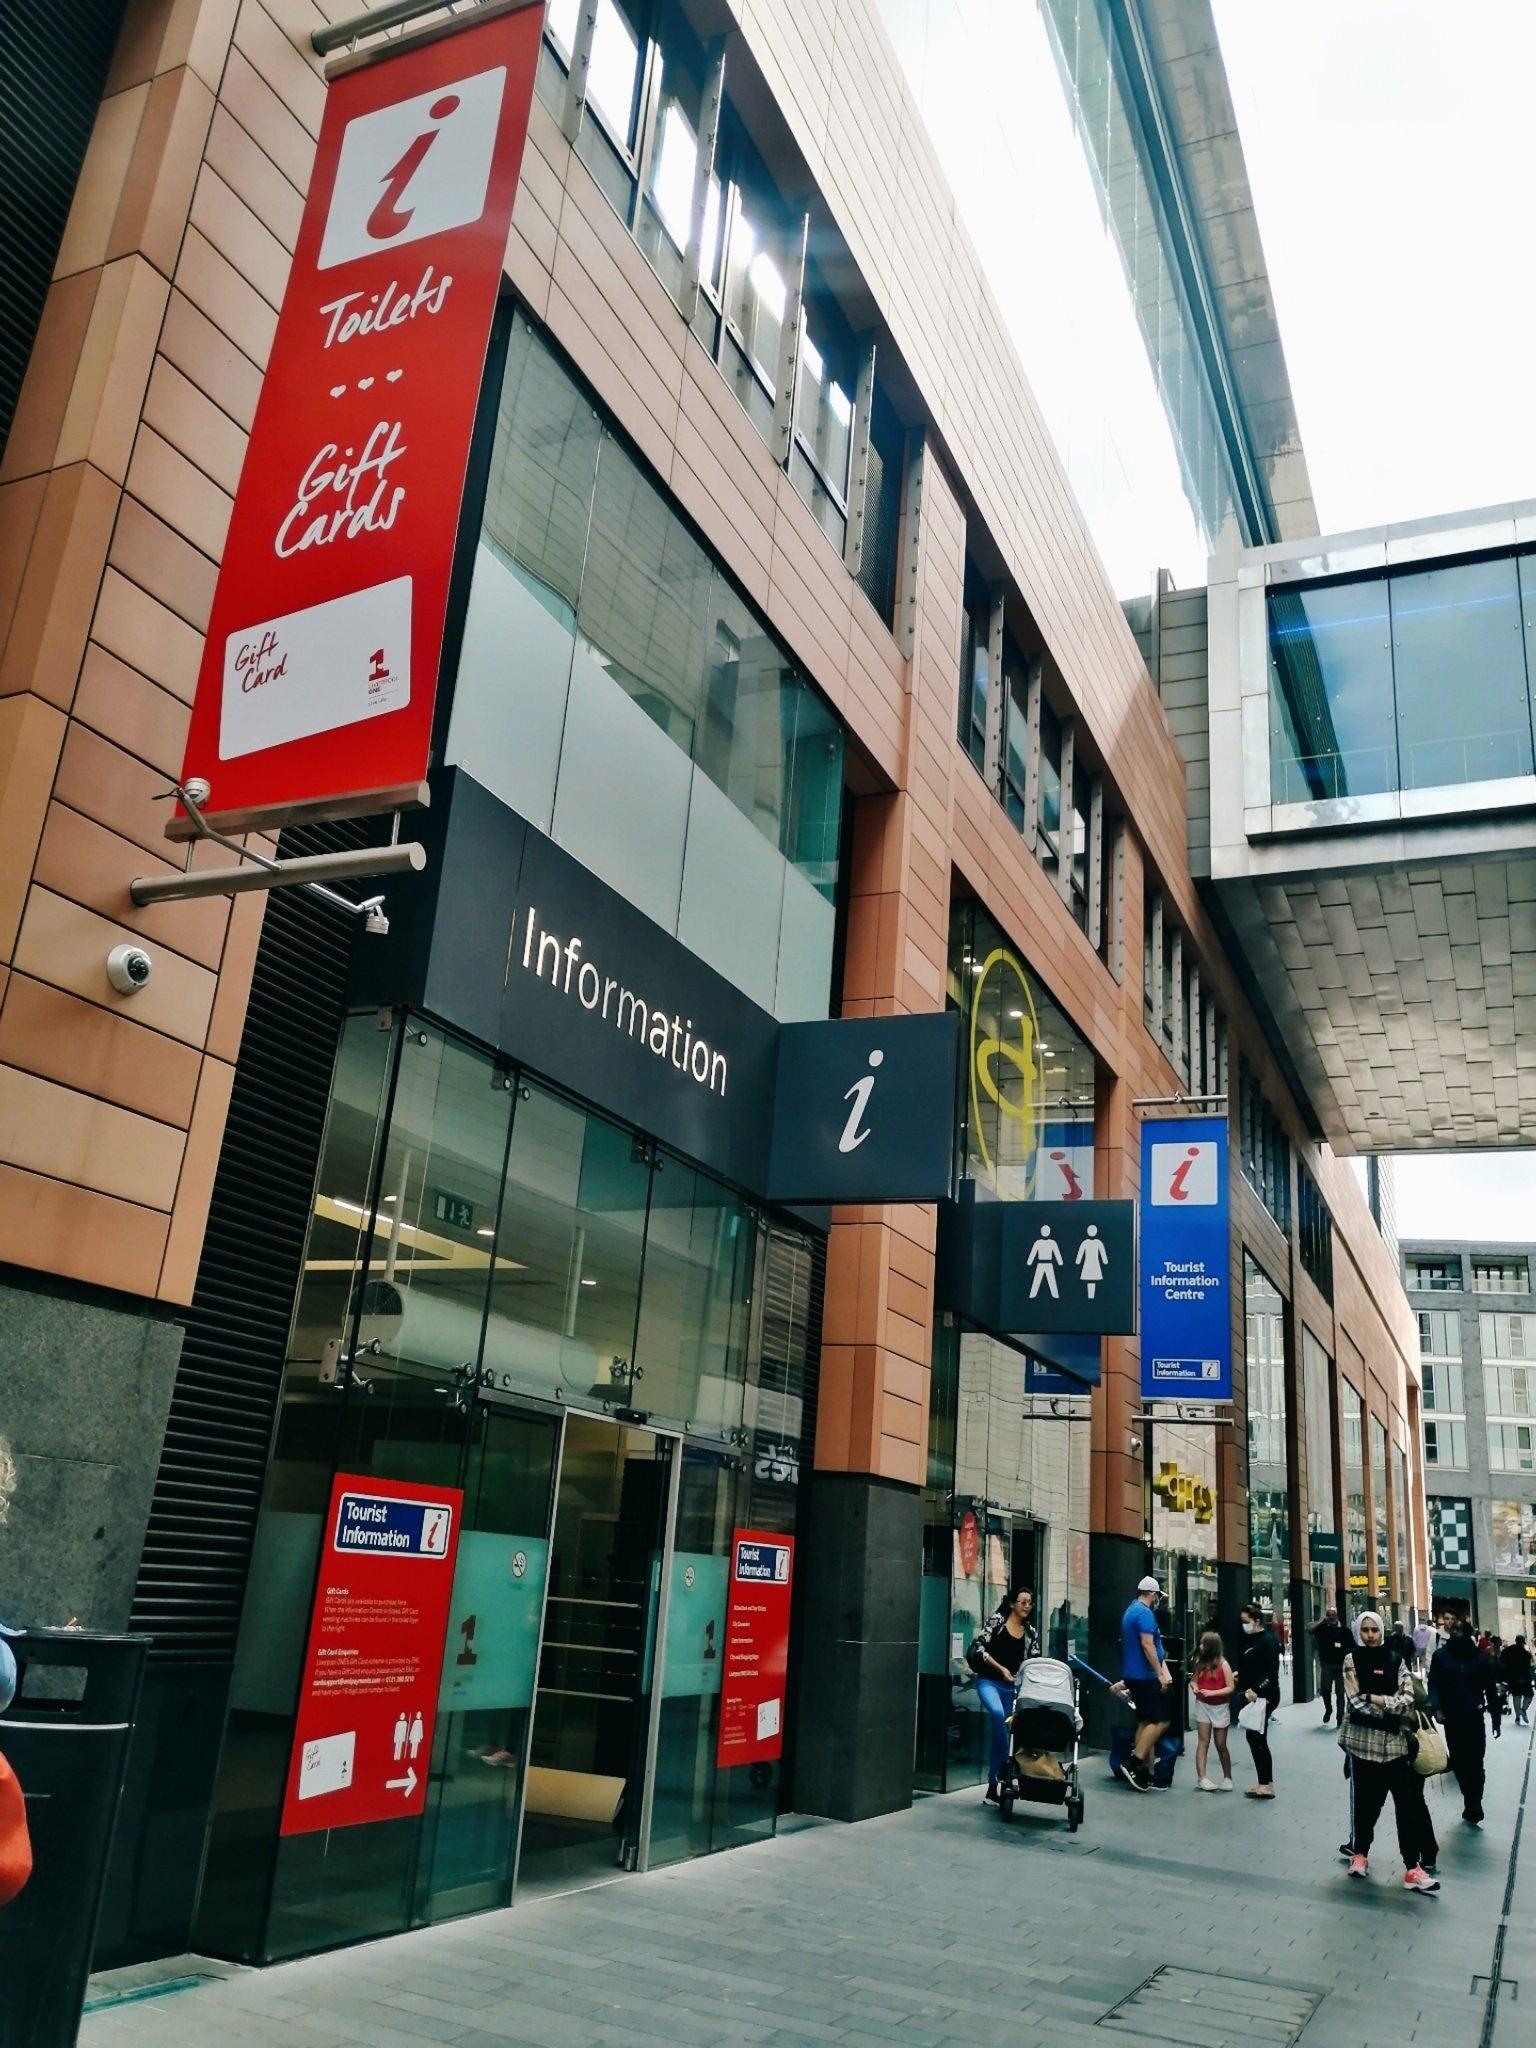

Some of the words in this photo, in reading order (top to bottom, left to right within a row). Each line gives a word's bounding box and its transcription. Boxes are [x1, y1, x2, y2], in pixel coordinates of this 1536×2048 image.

[318, 265, 453, 349] Toilets
[297, 421, 407, 510] Gift
[274, 479, 406, 559] Cards
[234, 631, 279, 672] Gift
[242, 653, 288, 694] Card
[368, 687, 381, 695] ONE
[521, 906, 728, 1097] Information
[1164, 1261, 1205, 1273] Tourist
[1150, 1274, 1219, 1287] Information
[1165, 1288, 1205, 1300] Centre
[1156, 1361, 1181, 1369] Tourist
[1156, 1369, 1196, 1377] Information
[346, 1501, 388, 1523] Tourist
[341, 1525, 410, 1548] Information
[740, 1546, 760, 1561] Tourist
[738, 1563, 771, 1578] Information
